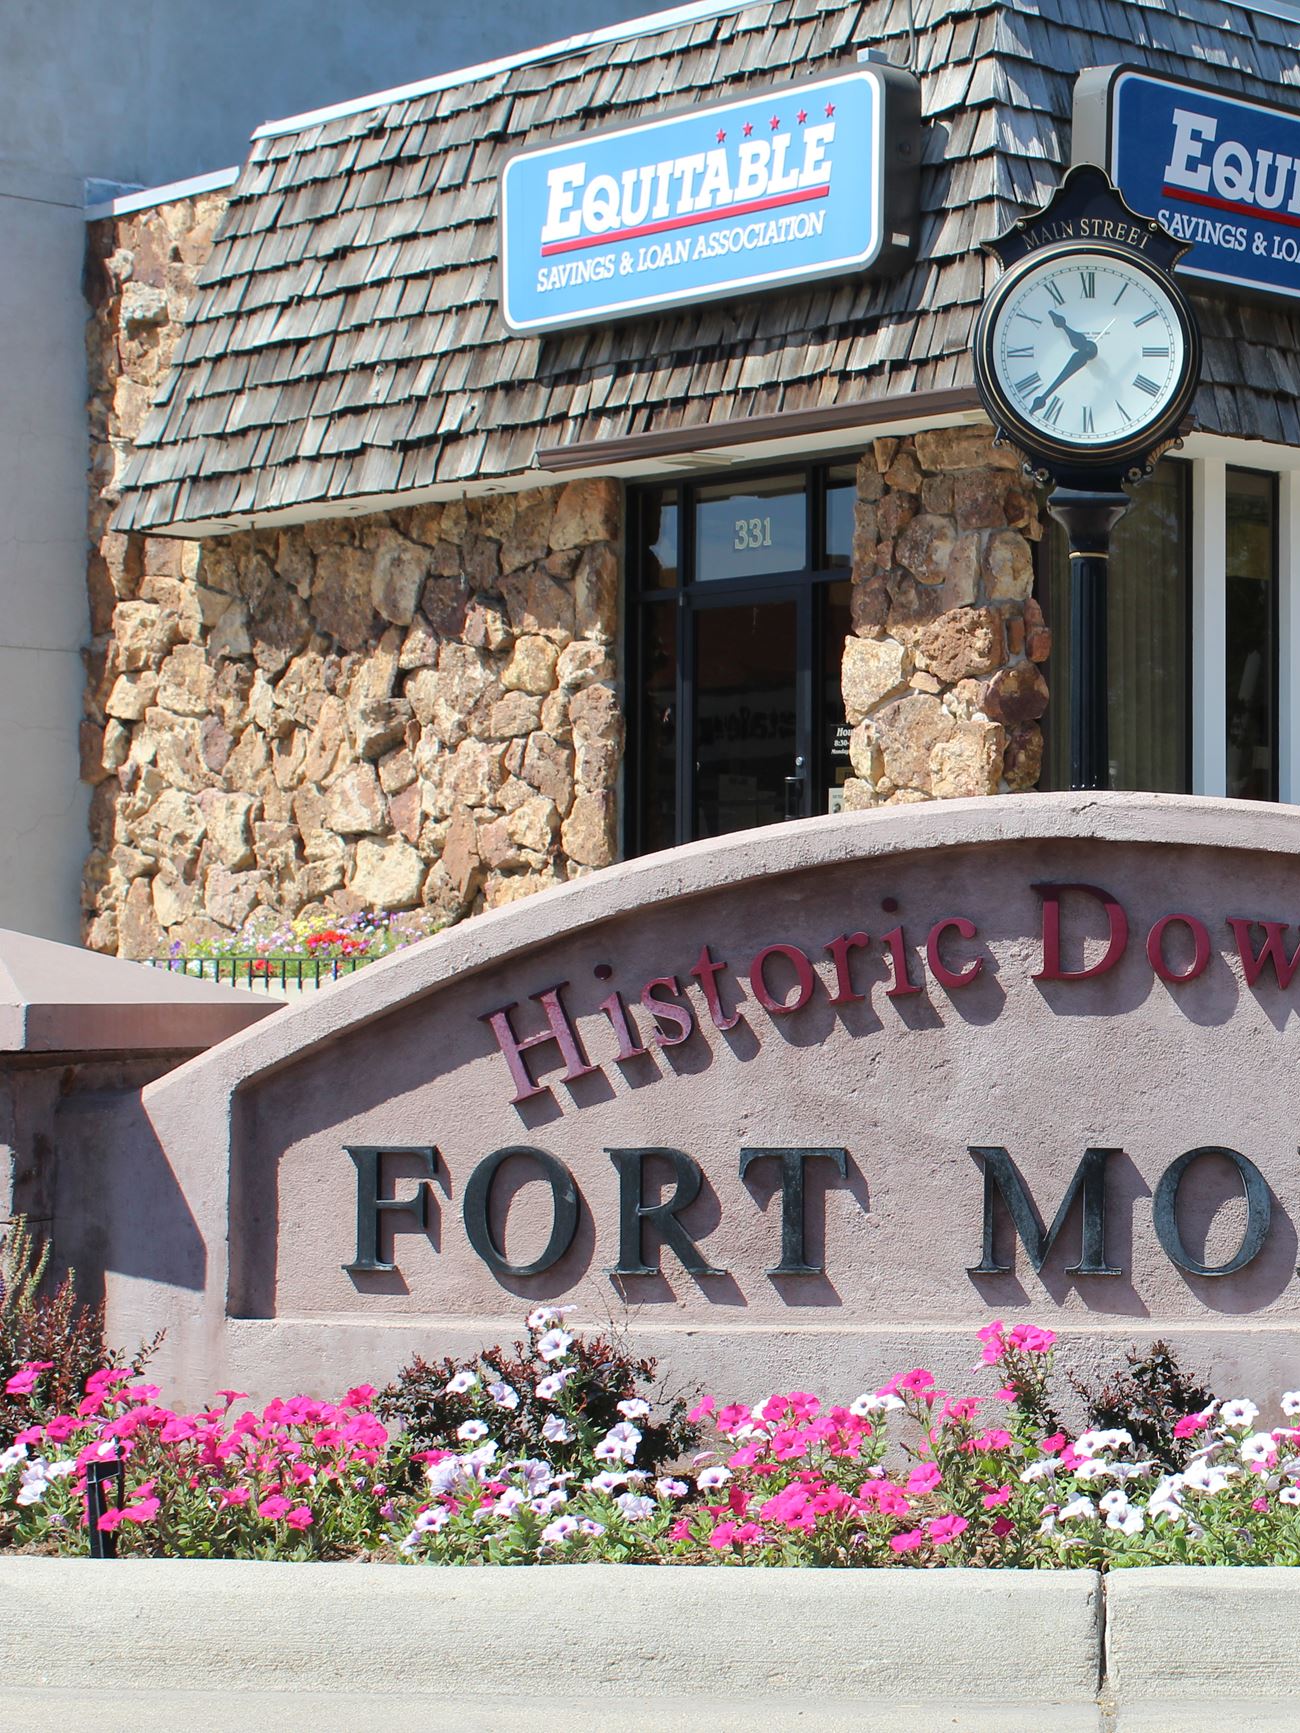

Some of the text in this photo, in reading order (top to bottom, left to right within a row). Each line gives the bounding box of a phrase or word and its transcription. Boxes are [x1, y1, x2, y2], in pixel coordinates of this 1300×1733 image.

[537, 209, 826, 293] SAVINGS & LOAN ASSOCIATION
[1022, 218, 1152, 250] MAIN STREET
[1157, 209, 1248, 251] SAVINGS
[1252, 232, 1267, 255] &
[734, 517, 772, 550] 331
[836, 727, 853, 737] Hou
[477, 898, 985, 1104] Historic
[341, 1144, 848, 1277] FORT
